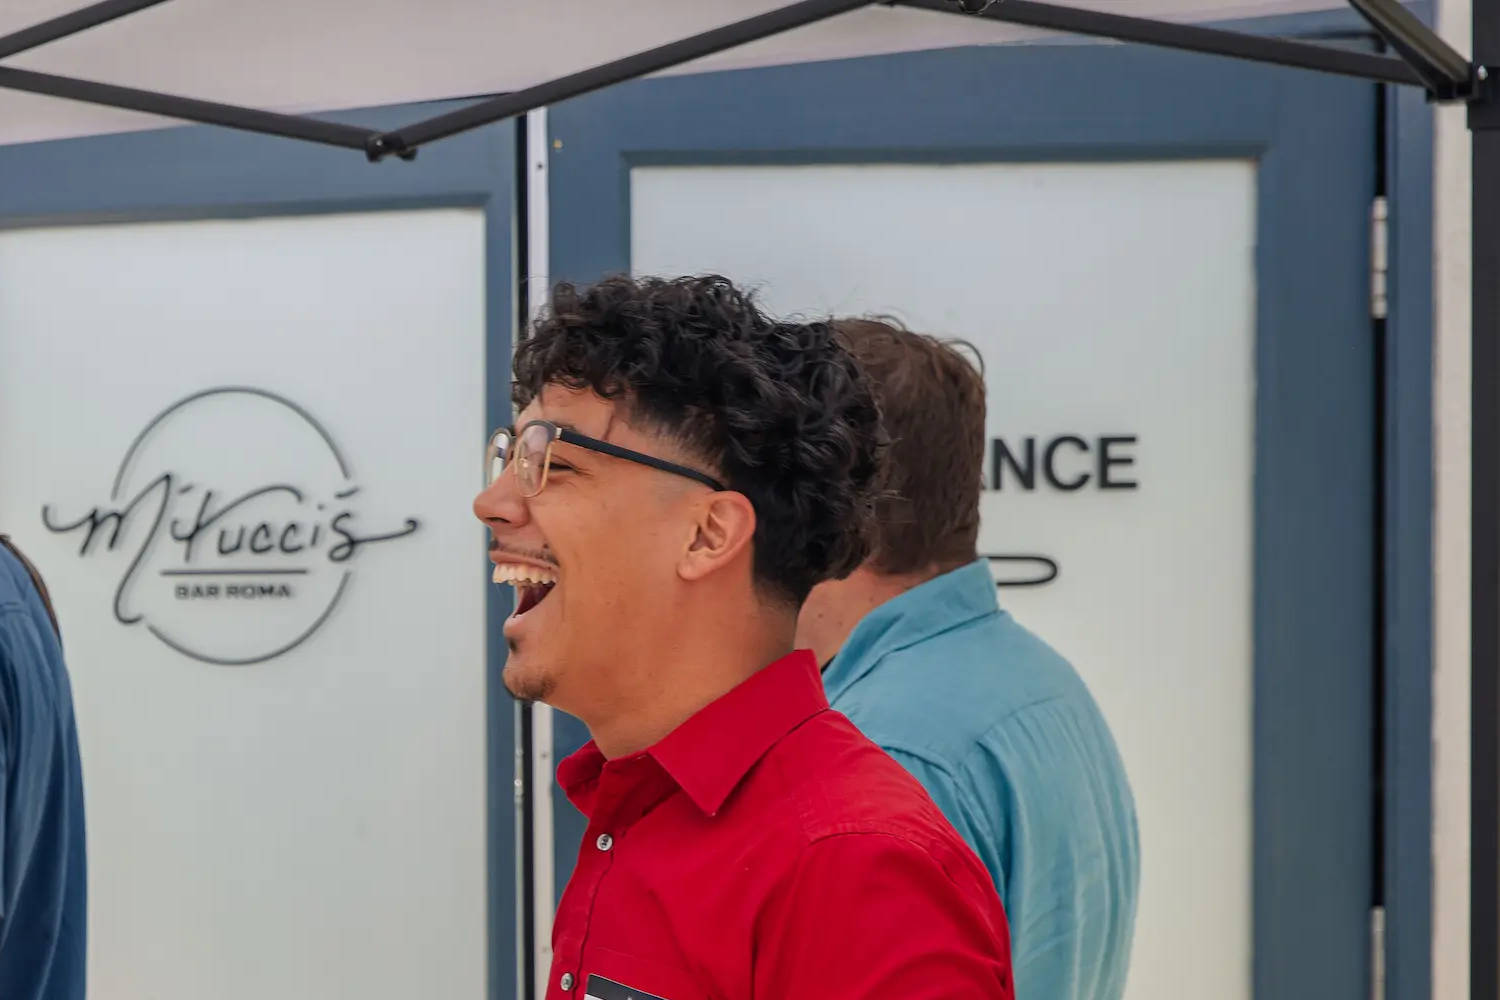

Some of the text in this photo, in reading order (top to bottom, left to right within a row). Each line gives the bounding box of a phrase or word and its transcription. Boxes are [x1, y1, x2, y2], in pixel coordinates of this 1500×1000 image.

[981, 435, 1138, 491] NCE
[175, 583, 293, 600] BAR ROMA
